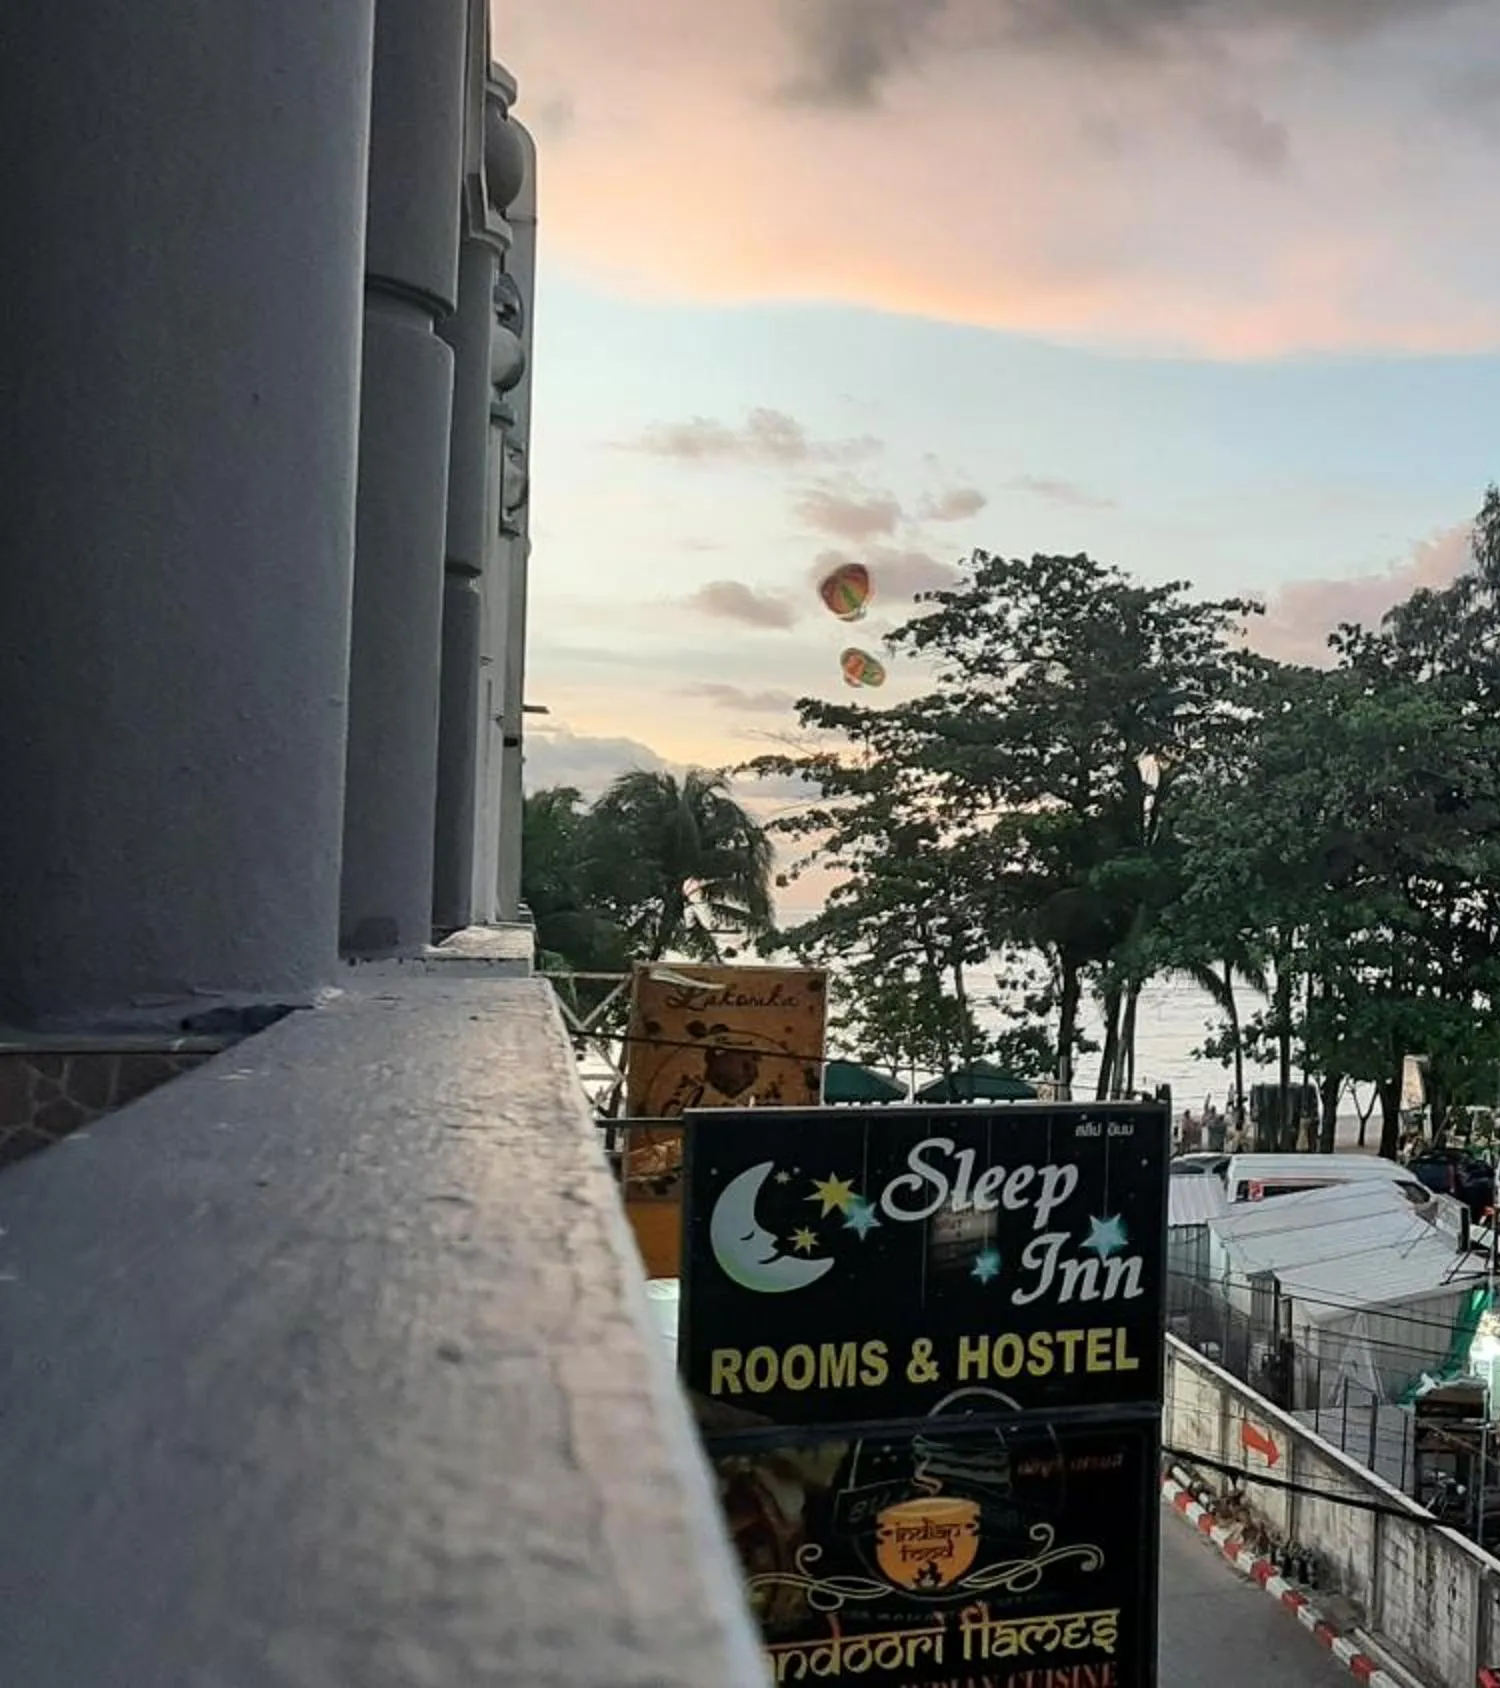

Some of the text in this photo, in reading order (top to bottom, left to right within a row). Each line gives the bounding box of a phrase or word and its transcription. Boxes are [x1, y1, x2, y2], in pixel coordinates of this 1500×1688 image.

[880, 1137, 1078, 1232] Sleep
[1011, 1232, 1144, 1306] Inn
[710, 1326, 1139, 1394] ROOMS & HOSTEL
